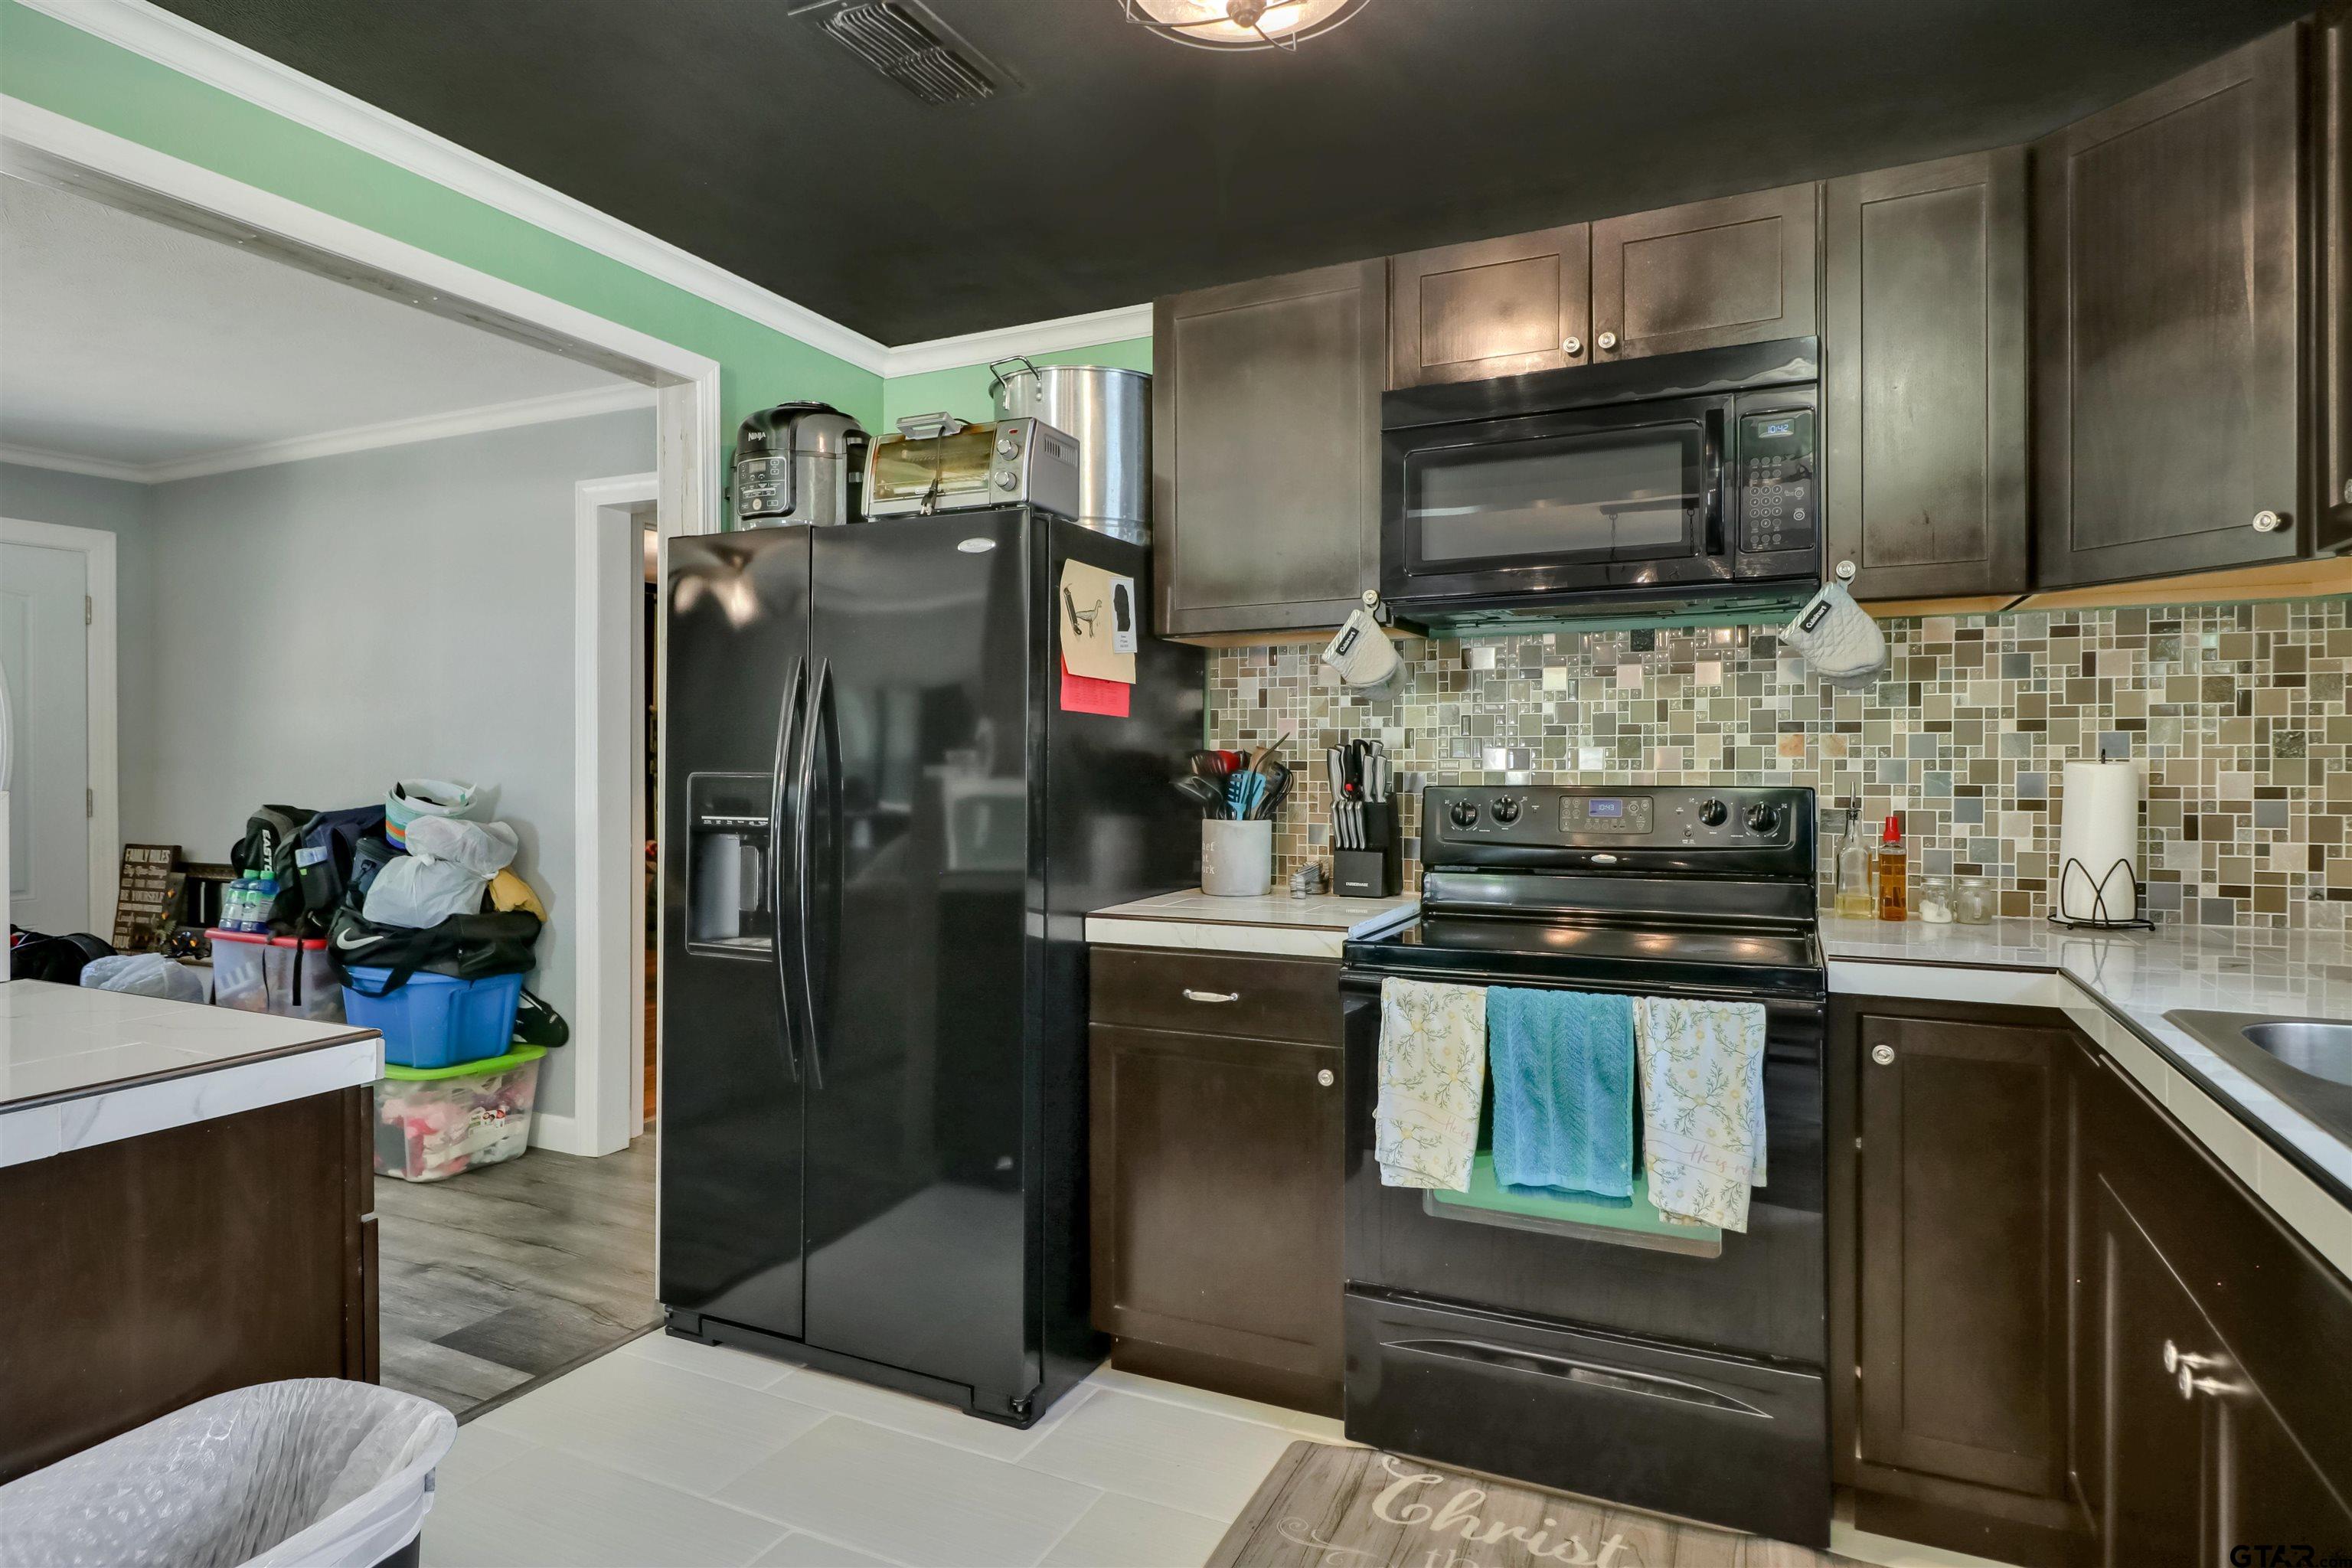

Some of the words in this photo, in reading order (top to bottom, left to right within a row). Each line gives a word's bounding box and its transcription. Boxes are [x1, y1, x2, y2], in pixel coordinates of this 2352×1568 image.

[1768, 423, 1788, 434] 10:42
[747, 432, 766, 442] NINJA
[1805, 605, 1828, 629] Cuisinart
[1598, 803, 1615, 812] 10:43
[261, 828, 274, 872] EASTO
[1202, 840, 1215, 851] hef
[1202, 864, 1215, 874] ork
[1371, 1455, 1628, 1568] Christ
